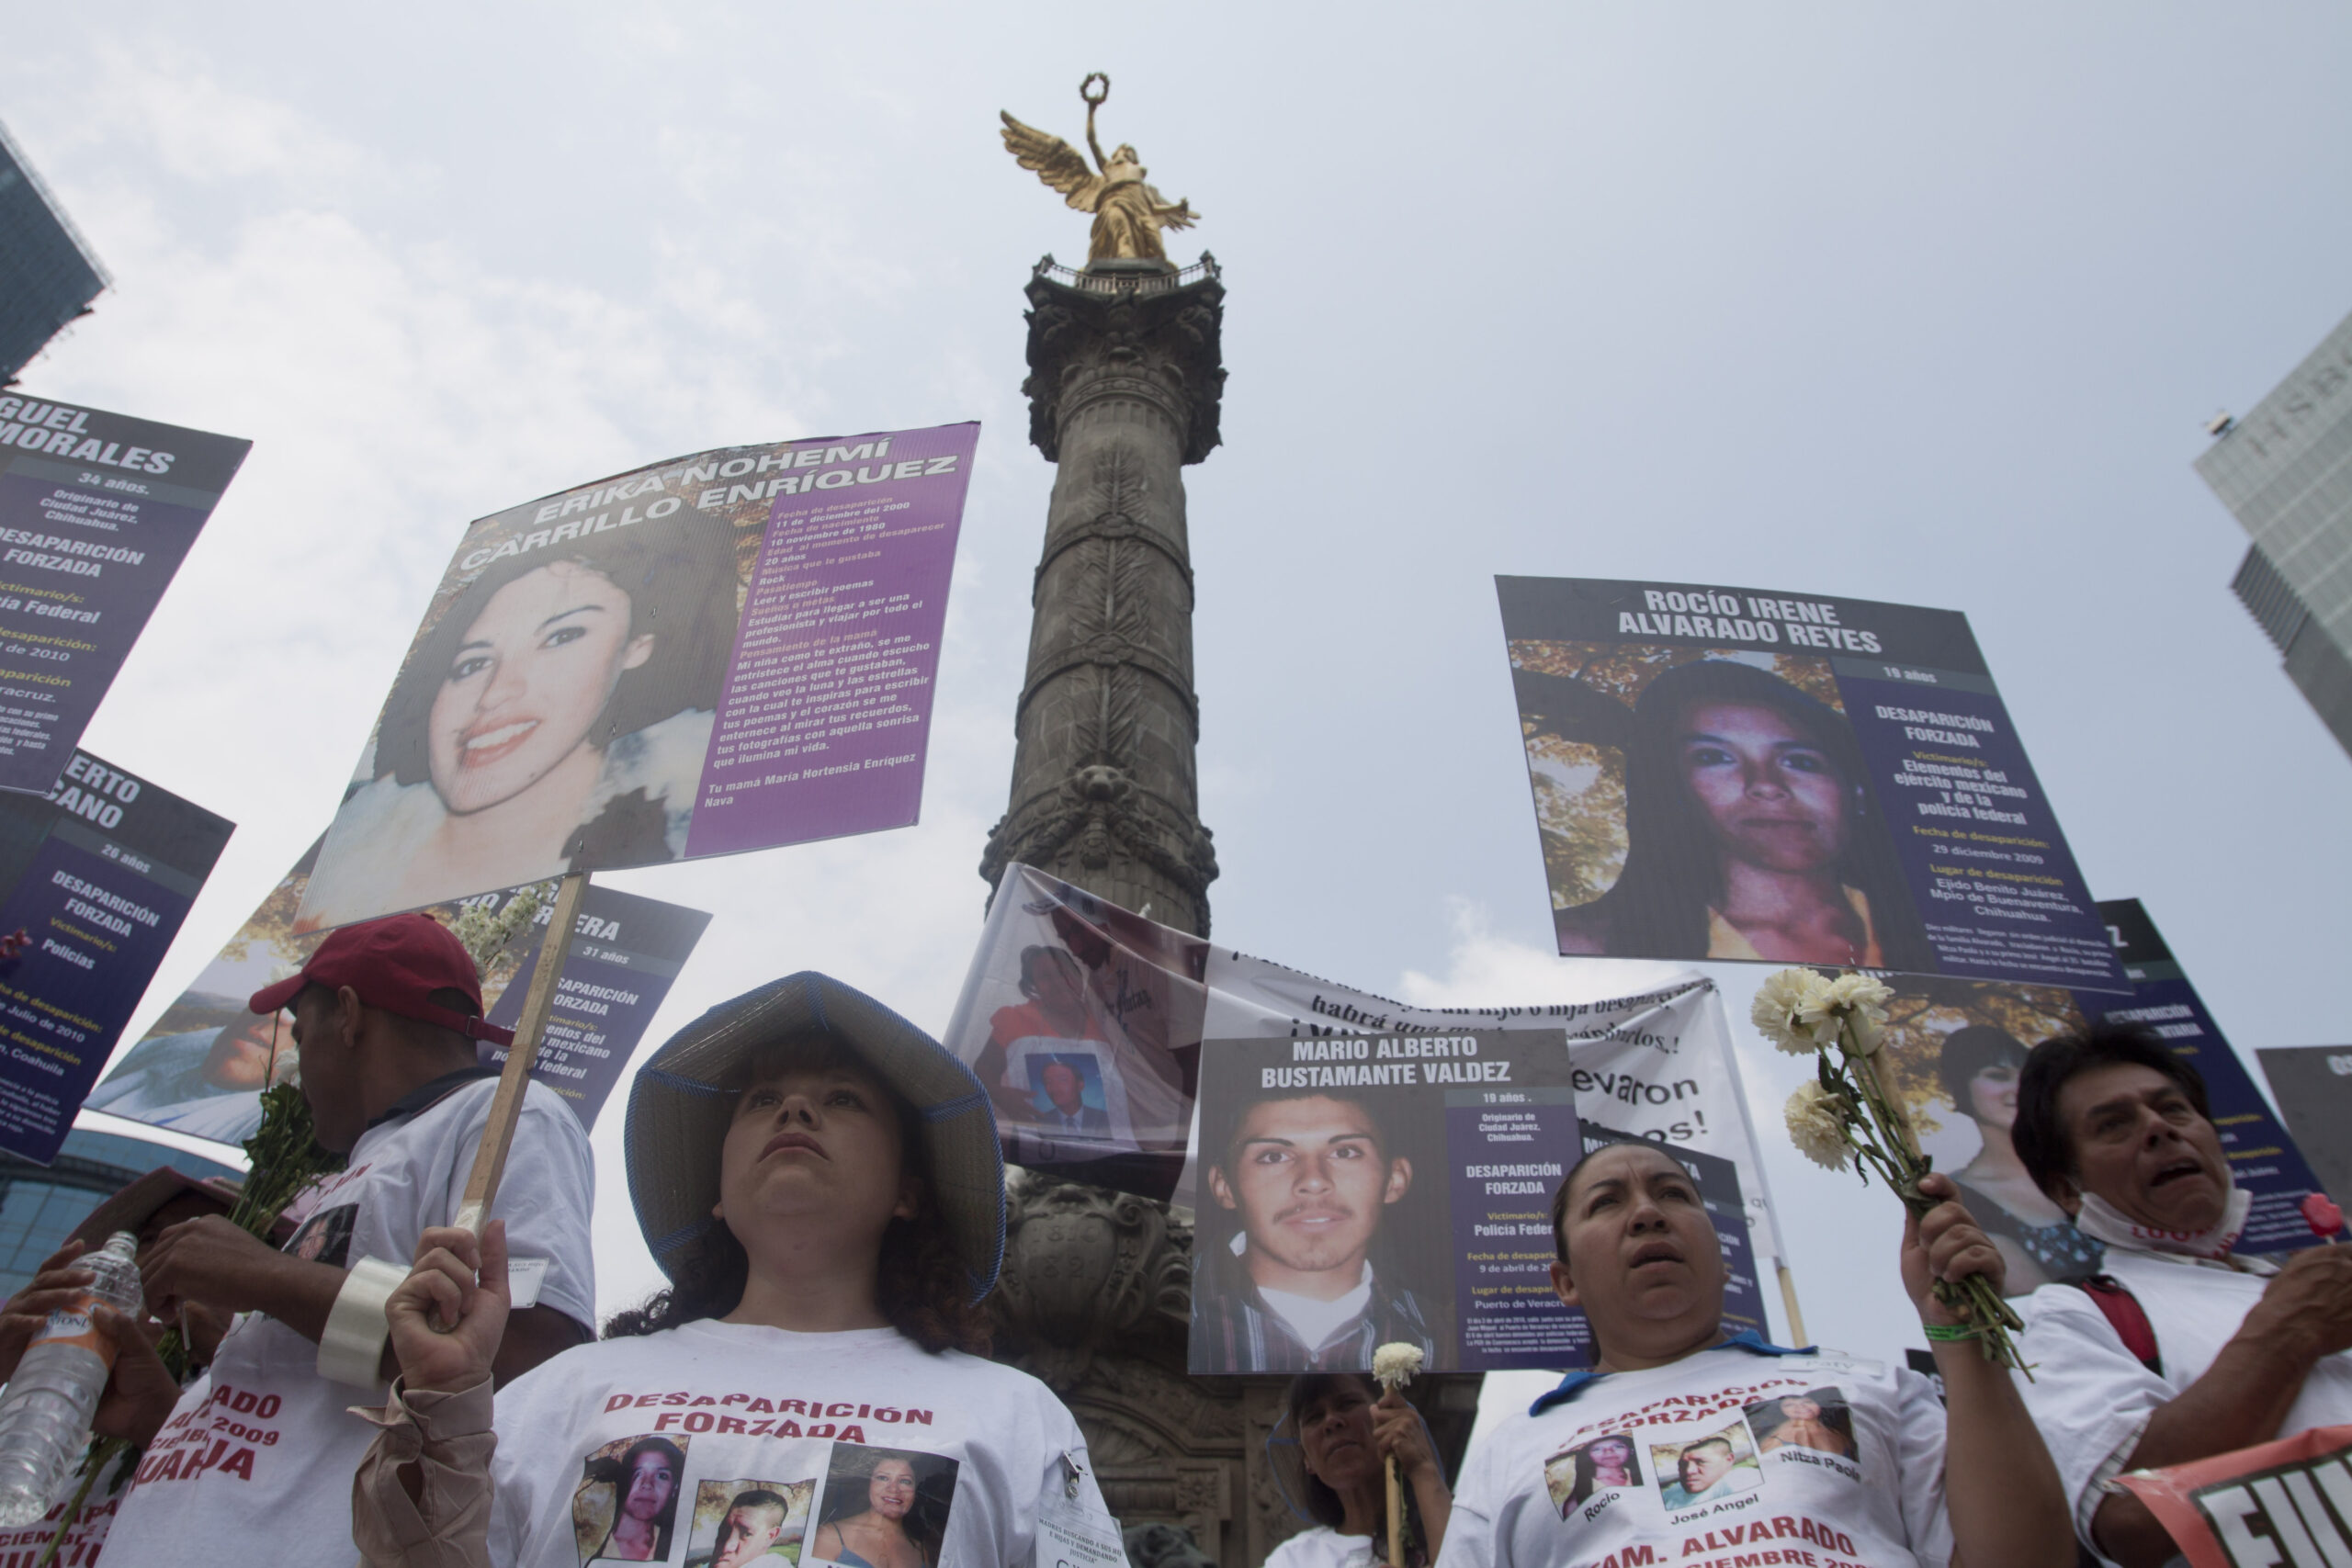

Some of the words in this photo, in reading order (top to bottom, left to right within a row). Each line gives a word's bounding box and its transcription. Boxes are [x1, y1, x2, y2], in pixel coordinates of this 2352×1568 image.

[680, 437, 893, 486] NOHEMÍ
[78, 472, 101, 485] 34
[105, 479, 149, 494] años.
[697, 455, 958, 509] ENRÍQUEZ
[40, 498, 88, 513] Ciudad
[53, 490, 119, 508] Originario
[121, 502, 139, 512] de
[534, 477, 665, 525] ERIKA
[809, 510, 860, 523] diciembre
[864, 505, 879, 514] del
[882, 502, 910, 512] 2000
[461, 497, 681, 570] CARRILLO
[771, 538, 783, 547] 10
[786, 530, 839, 544] noviembre
[860, 522, 885, 532] 1980
[4, 548, 101, 577] FORZADA
[763, 557, 778, 566] 20
[781, 553, 806, 562] años
[759, 574, 785, 585] Rock
[752, 595, 776, 606] Leer
[779, 594, 786, 603] y
[788, 586, 829, 599] escribir
[831, 580, 873, 593] poemas
[24, 600, 100, 623] Federal
[744, 619, 815, 639] profesionista
[818, 617, 825, 626] y
[828, 612, 859, 623] viajar
[862, 608, 880, 618] por
[884, 604, 908, 613] todo
[911, 600, 922, 608] el
[747, 613, 792, 626] Estudiar
[794, 608, 820, 620] para
[823, 603, 854, 613] llegar
[868, 597, 886, 605] ser
[888, 593, 910, 602] una
[5, 644, 26, 654] de
[29, 648, 70, 660] 2010
[742, 636, 781, 648] mundo.
[65, 755, 140, 802] ERTO
[709, 784, 722, 794] Tu
[725, 778, 760, 791] mamá
[764, 772, 798, 784] María
[802, 761, 859, 778] Hortensia
[864, 753, 915, 768] Enríquez
[704, 796, 733, 807] Nava
[101, 843, 119, 858] 26
[119, 853, 150, 873] años
[52, 871, 159, 926] DESAPARICIÓN
[64, 898, 131, 936] FORZADA
[41, 939, 95, 968] Policías
[6, 1006, 37, 1022] Julio
[39, 1019, 54, 1030] de
[55, 1024, 85, 1042] 2010
[1311, 994, 1388, 1030] habrá
[1293, 1040, 1368, 1060] MARIO
[1376, 1036, 1476, 1057] ALBERTO
[11, 1048, 64, 1076] Coahuila
[1261, 1064, 1415, 1088] BUSTAMANTE
[1423, 1061, 1510, 1082] VALDEZ
[1483, 1092, 1496, 1102] 19
[1498, 1092, 1525, 1102] años
[1478, 1123, 1508, 1132] Ciudad
[1510, 1122, 1540, 1131] Juárez.
[1481, 1113, 1522, 1122] Originario
[1524, 1112, 1535, 1121] de
[1466, 1163, 1561, 1178] DESAPARICIÓN
[1485, 1181, 1544, 1194] FORZADA
[1474, 1224, 1516, 1235] Policía
[1466, 1252, 1495, 1260] Fecha
[1479, 1264, 1486, 1272] 9
[1487, 1264, 1500, 1272] de
[1502, 1264, 1524, 1272] abril
[1526, 1263, 1539, 1271] de
[1474, 1300, 1510, 1309] Puerto
[1511, 1300, 1525, 1308] de
[604, 1392, 933, 1426] DESAPARICIÓN
[1600, 1394, 1767, 1438] FORZADA
[211, 1416, 280, 1447] 2009
[654, 1411, 866, 1443] FORZADA
[1781, 1450, 1821, 1468] Nitza
[1670, 1507, 1709, 1526] José
[1713, 1494, 1760, 1517] Angel
[1682, 1516, 1857, 1558] ALVARADO
